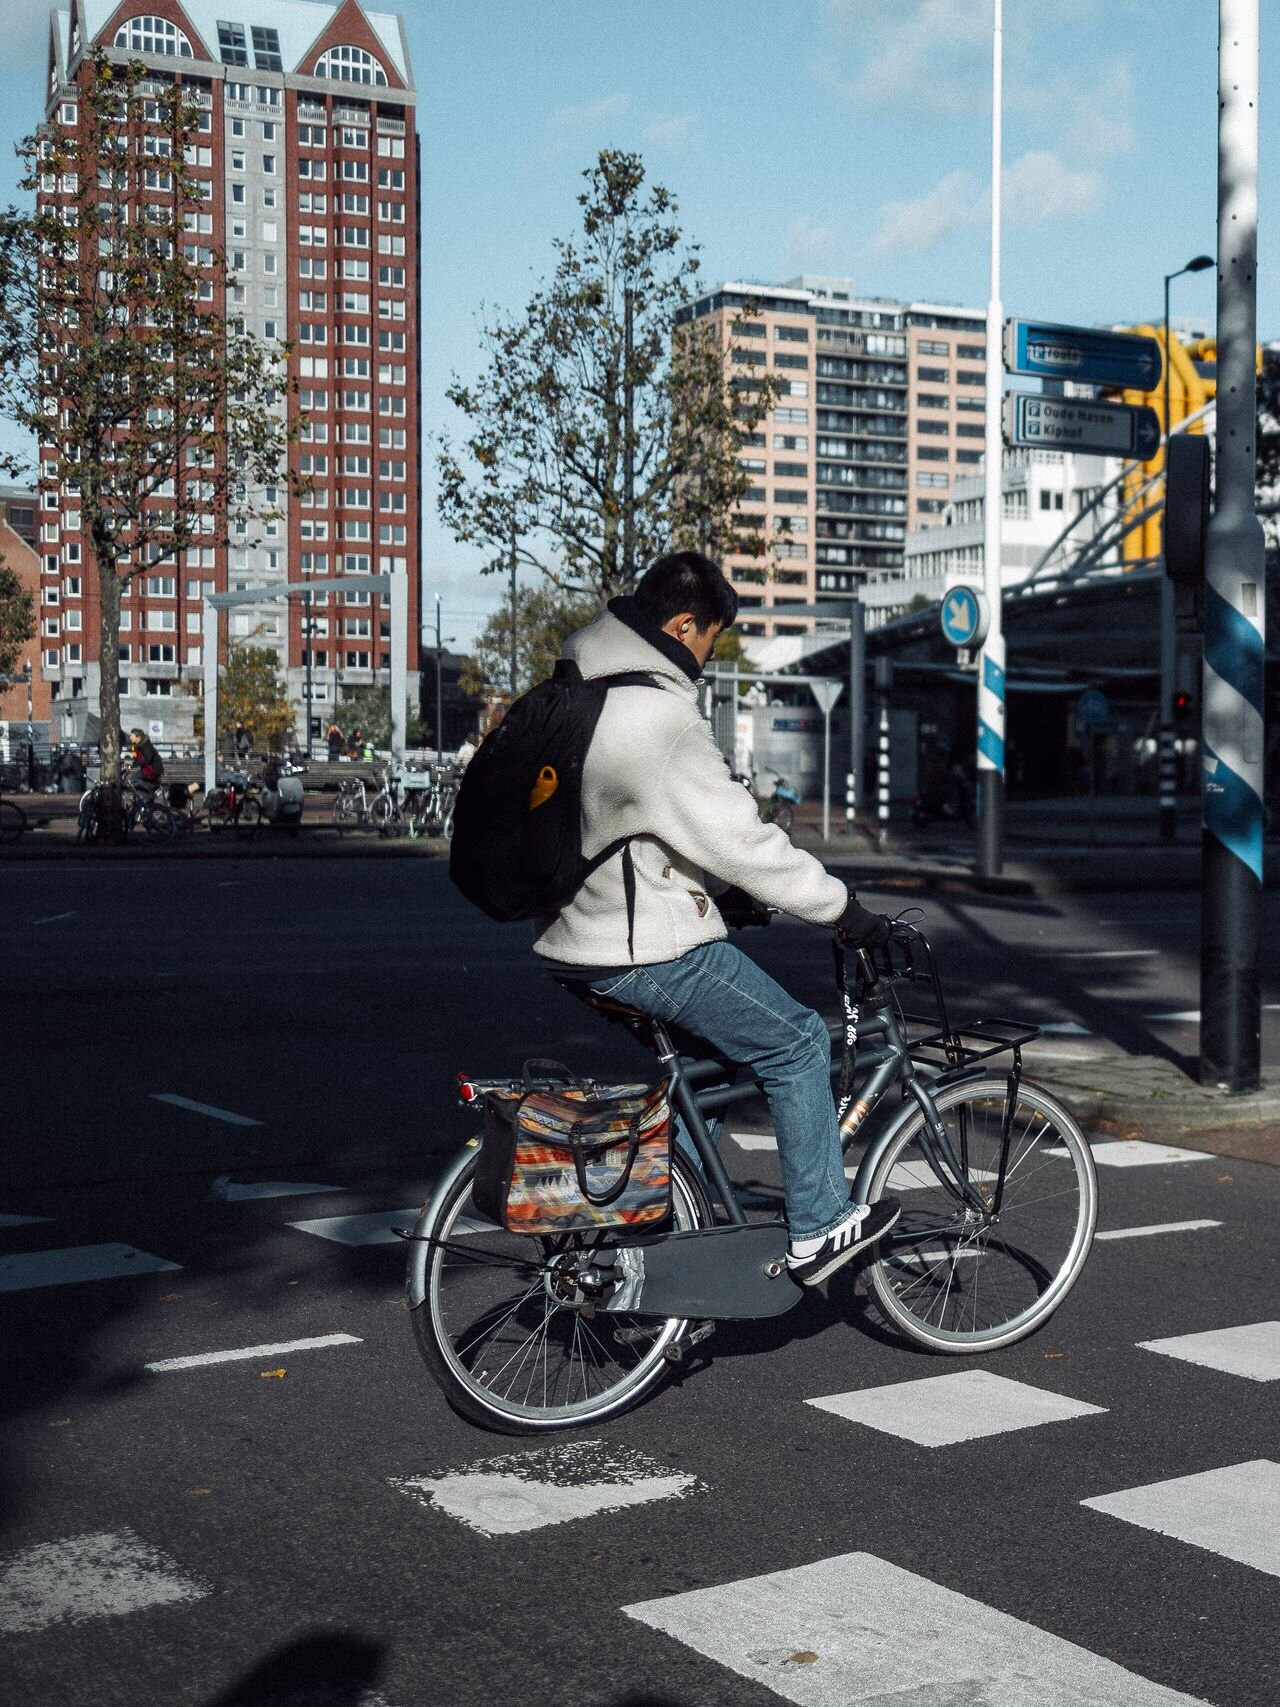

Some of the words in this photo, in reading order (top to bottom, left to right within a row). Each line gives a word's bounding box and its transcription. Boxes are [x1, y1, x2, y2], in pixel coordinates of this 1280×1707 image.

[1047, 348, 1080, 361] route
[1043, 405, 1073, 420] Oude
[1077, 411, 1114, 424] Haven
[1043, 424, 1082, 439] Kiphof
